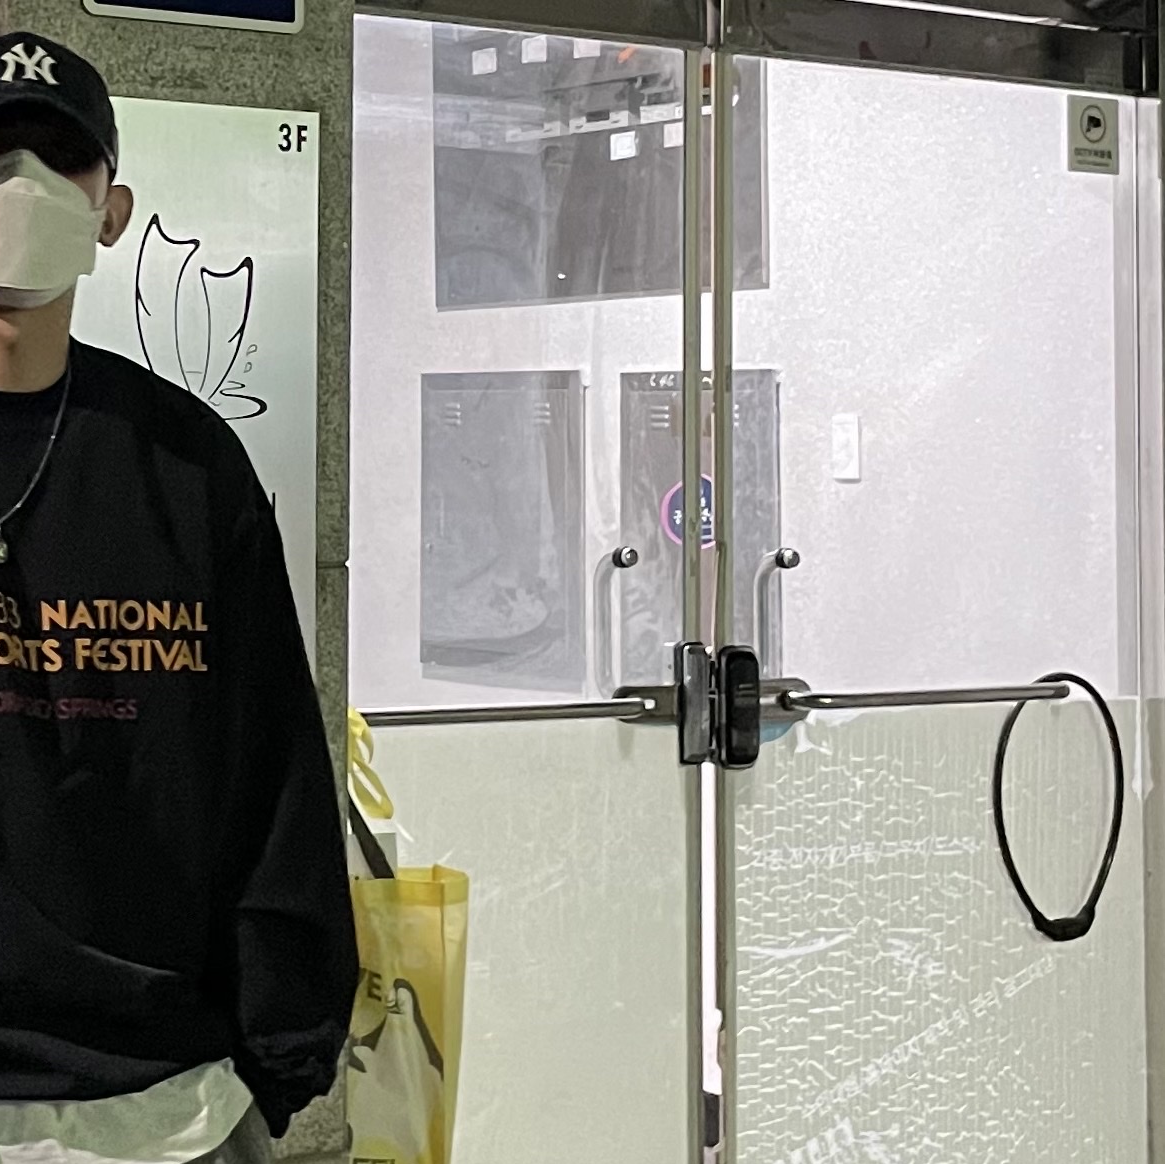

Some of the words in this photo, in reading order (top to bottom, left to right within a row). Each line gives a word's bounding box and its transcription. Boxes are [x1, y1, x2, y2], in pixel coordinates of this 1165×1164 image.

[0, 42, 60, 85] NY
[277, 122, 308, 153] 3F
[40, 599, 209, 632] NATIONAL
[74, 637, 209, 672] FESTIVAL
